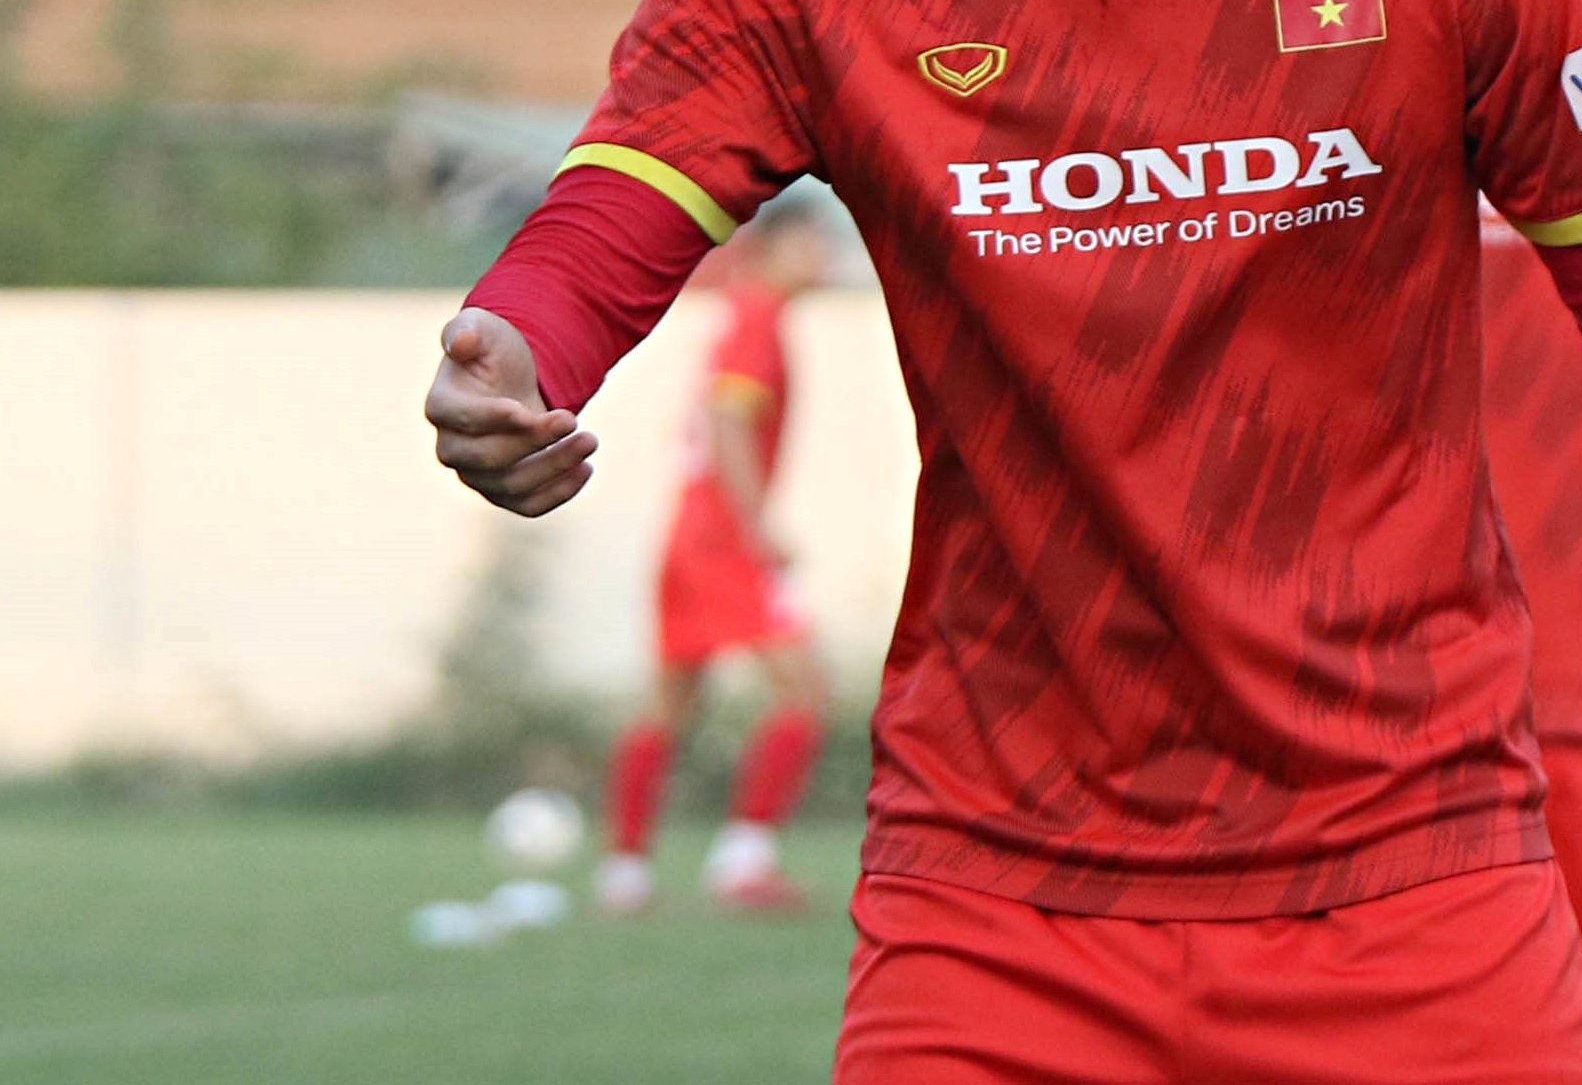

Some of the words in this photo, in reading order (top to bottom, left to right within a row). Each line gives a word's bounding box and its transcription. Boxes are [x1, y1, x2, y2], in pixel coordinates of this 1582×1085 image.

[947, 127, 1383, 215] HONDA
[968, 228, 1042, 257] The
[1050, 219, 1171, 253] Power
[1179, 211, 1218, 243] of
[1229, 195, 1365, 237] Dreams
